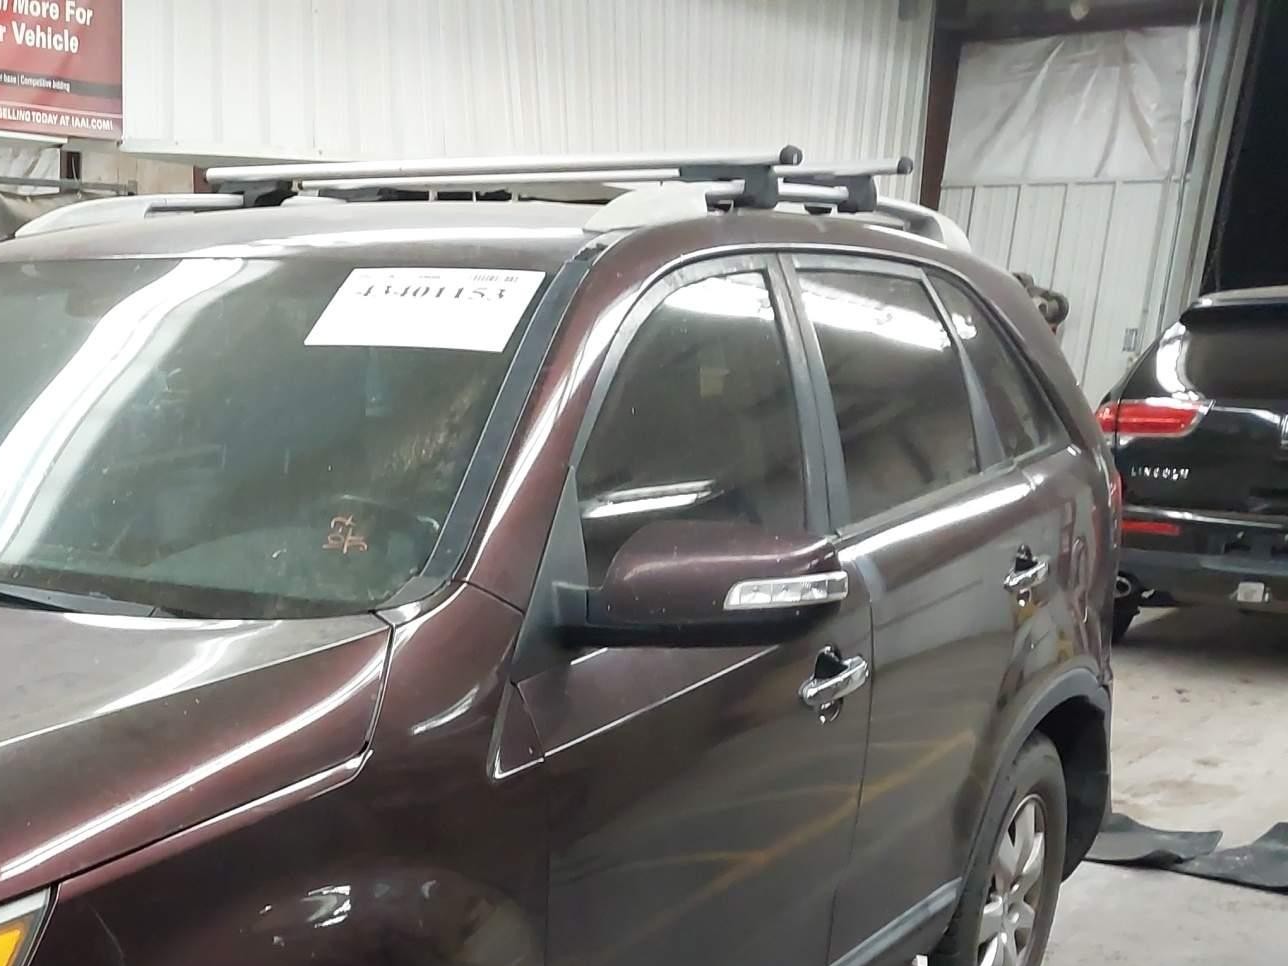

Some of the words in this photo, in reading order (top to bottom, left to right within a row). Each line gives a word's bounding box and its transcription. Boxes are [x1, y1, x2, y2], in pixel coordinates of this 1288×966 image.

[12, 0, 60, 21] More
[65, 0, 93, 26] For
[12, 21, 79, 54] Vehicle
[31, 111, 58, 125] TODAY
[59, 114, 70, 127] AT
[71, 116, 113, 131] IAAI.COM!
[1130, 465, 1191, 481] LINCOLN
